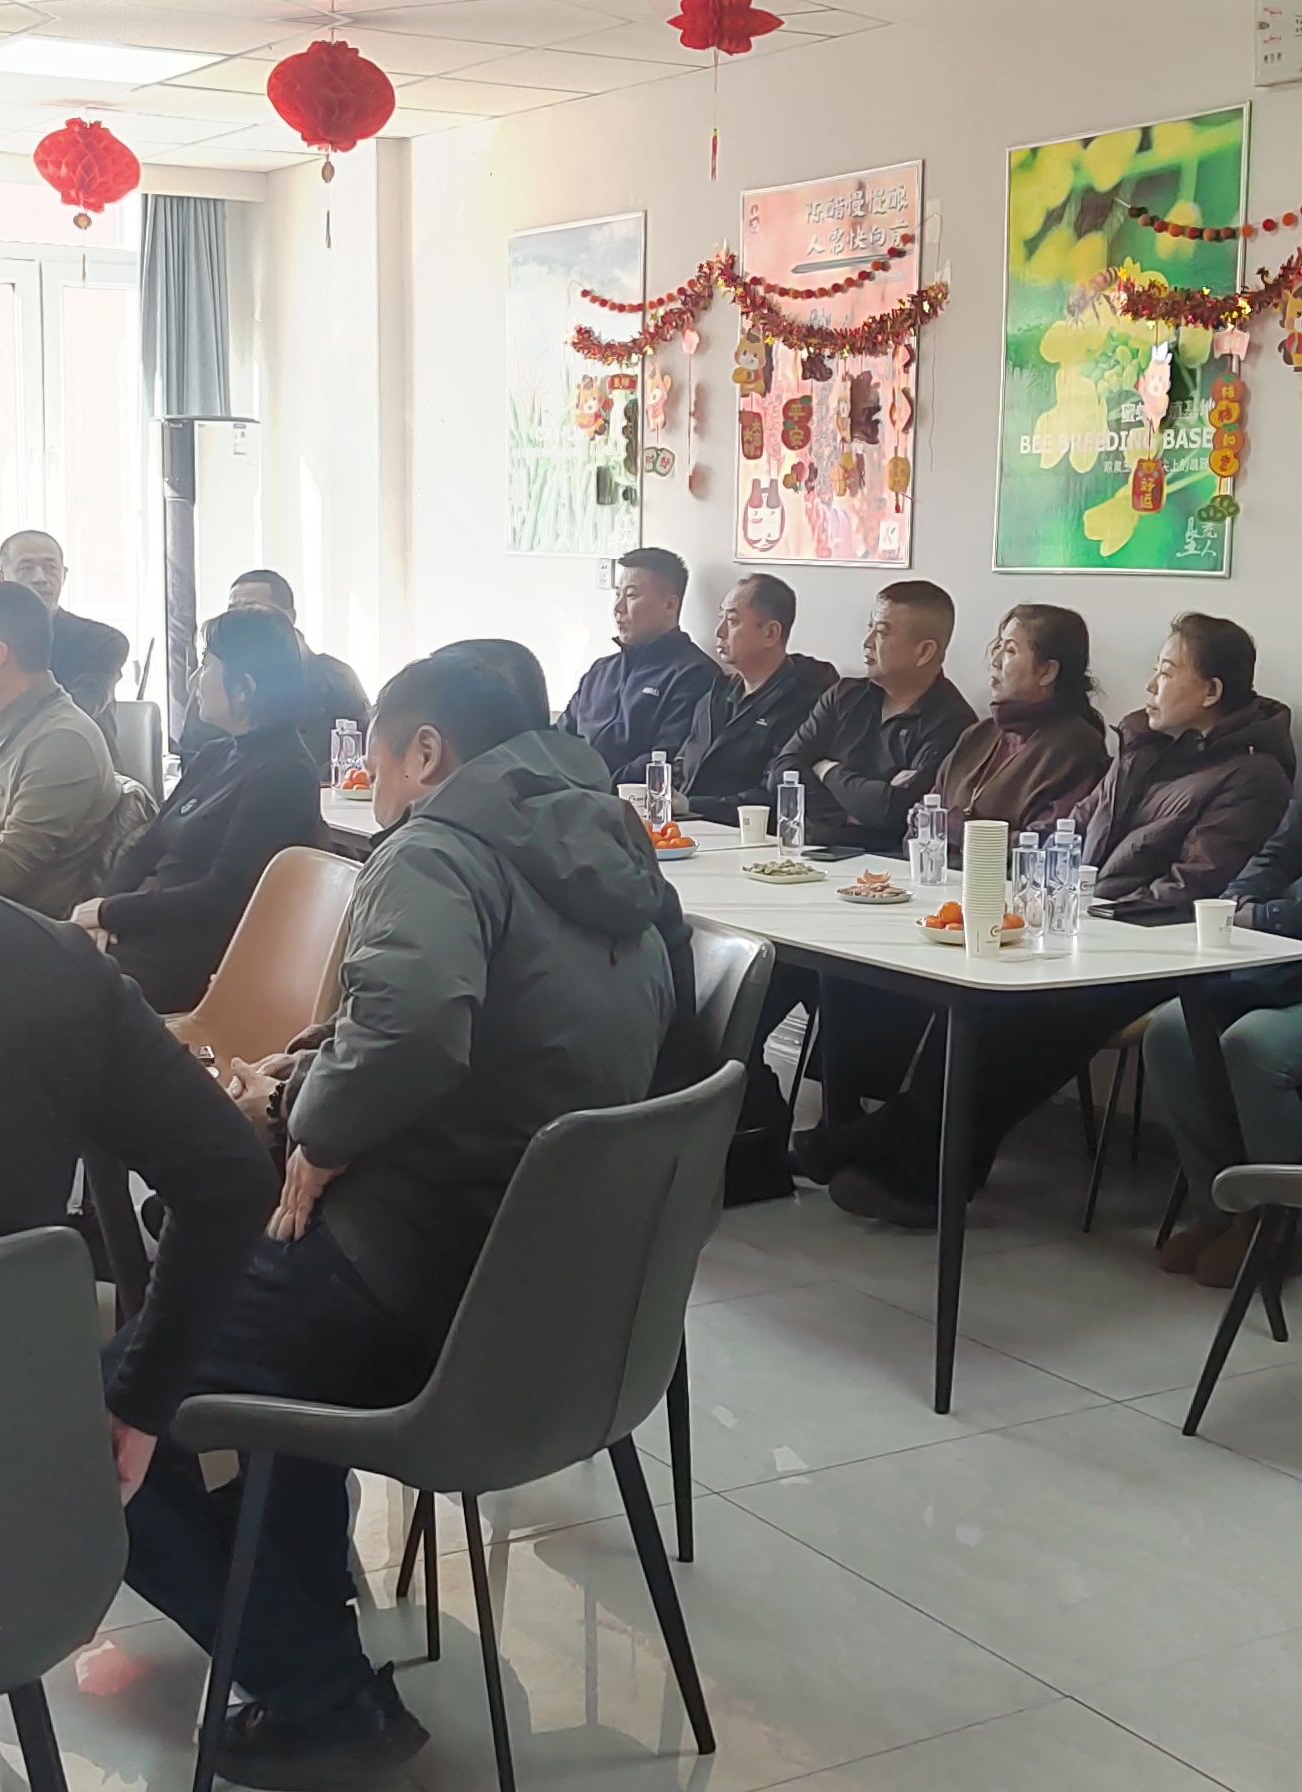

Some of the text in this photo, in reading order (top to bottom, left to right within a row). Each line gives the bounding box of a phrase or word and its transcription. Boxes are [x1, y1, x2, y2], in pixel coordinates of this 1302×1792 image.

[787, 402, 808, 447] 平安
[1020, 427, 1214, 455] BEE BREEDING BASE
[1139, 477, 1156, 509] 好运
